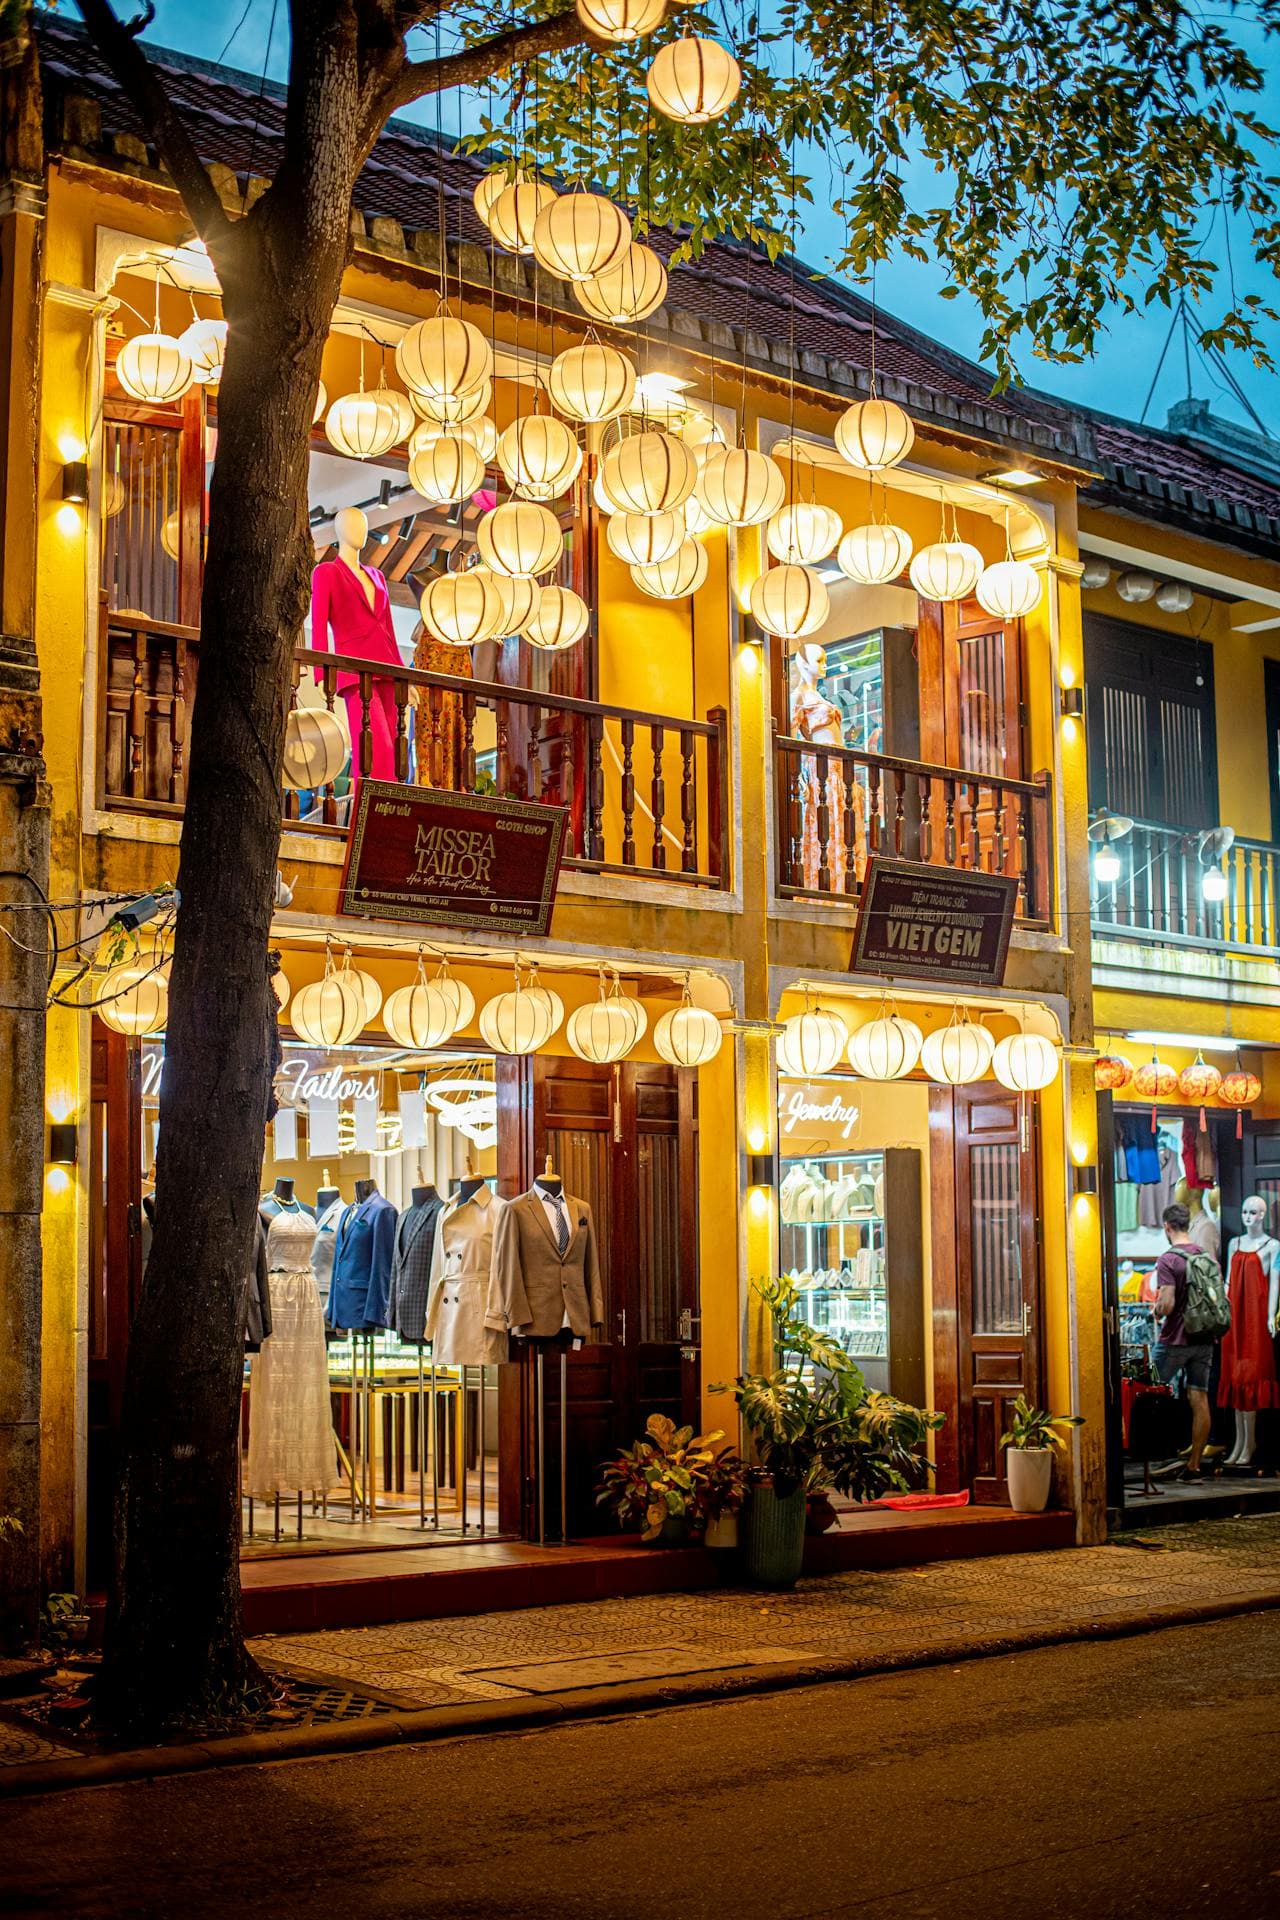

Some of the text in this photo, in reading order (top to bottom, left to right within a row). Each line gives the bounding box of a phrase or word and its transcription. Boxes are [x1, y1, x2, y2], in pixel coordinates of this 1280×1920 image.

[414, 824, 496, 858] MISSEA
[496, 820, 548, 835] CLOTH SHOP
[415, 848, 491, 881] TAILOR
[888, 904, 916, 919] LUXURY
[916, 908, 944, 923] JEWELRY
[950, 913, 984, 928] DIAMONDS
[928, 894, 952, 907] TRANG
[886, 921, 982, 958] VIET GEM
[282, 1060, 380, 1101] Tailors
[784, 1091, 860, 1139] Jewelry
